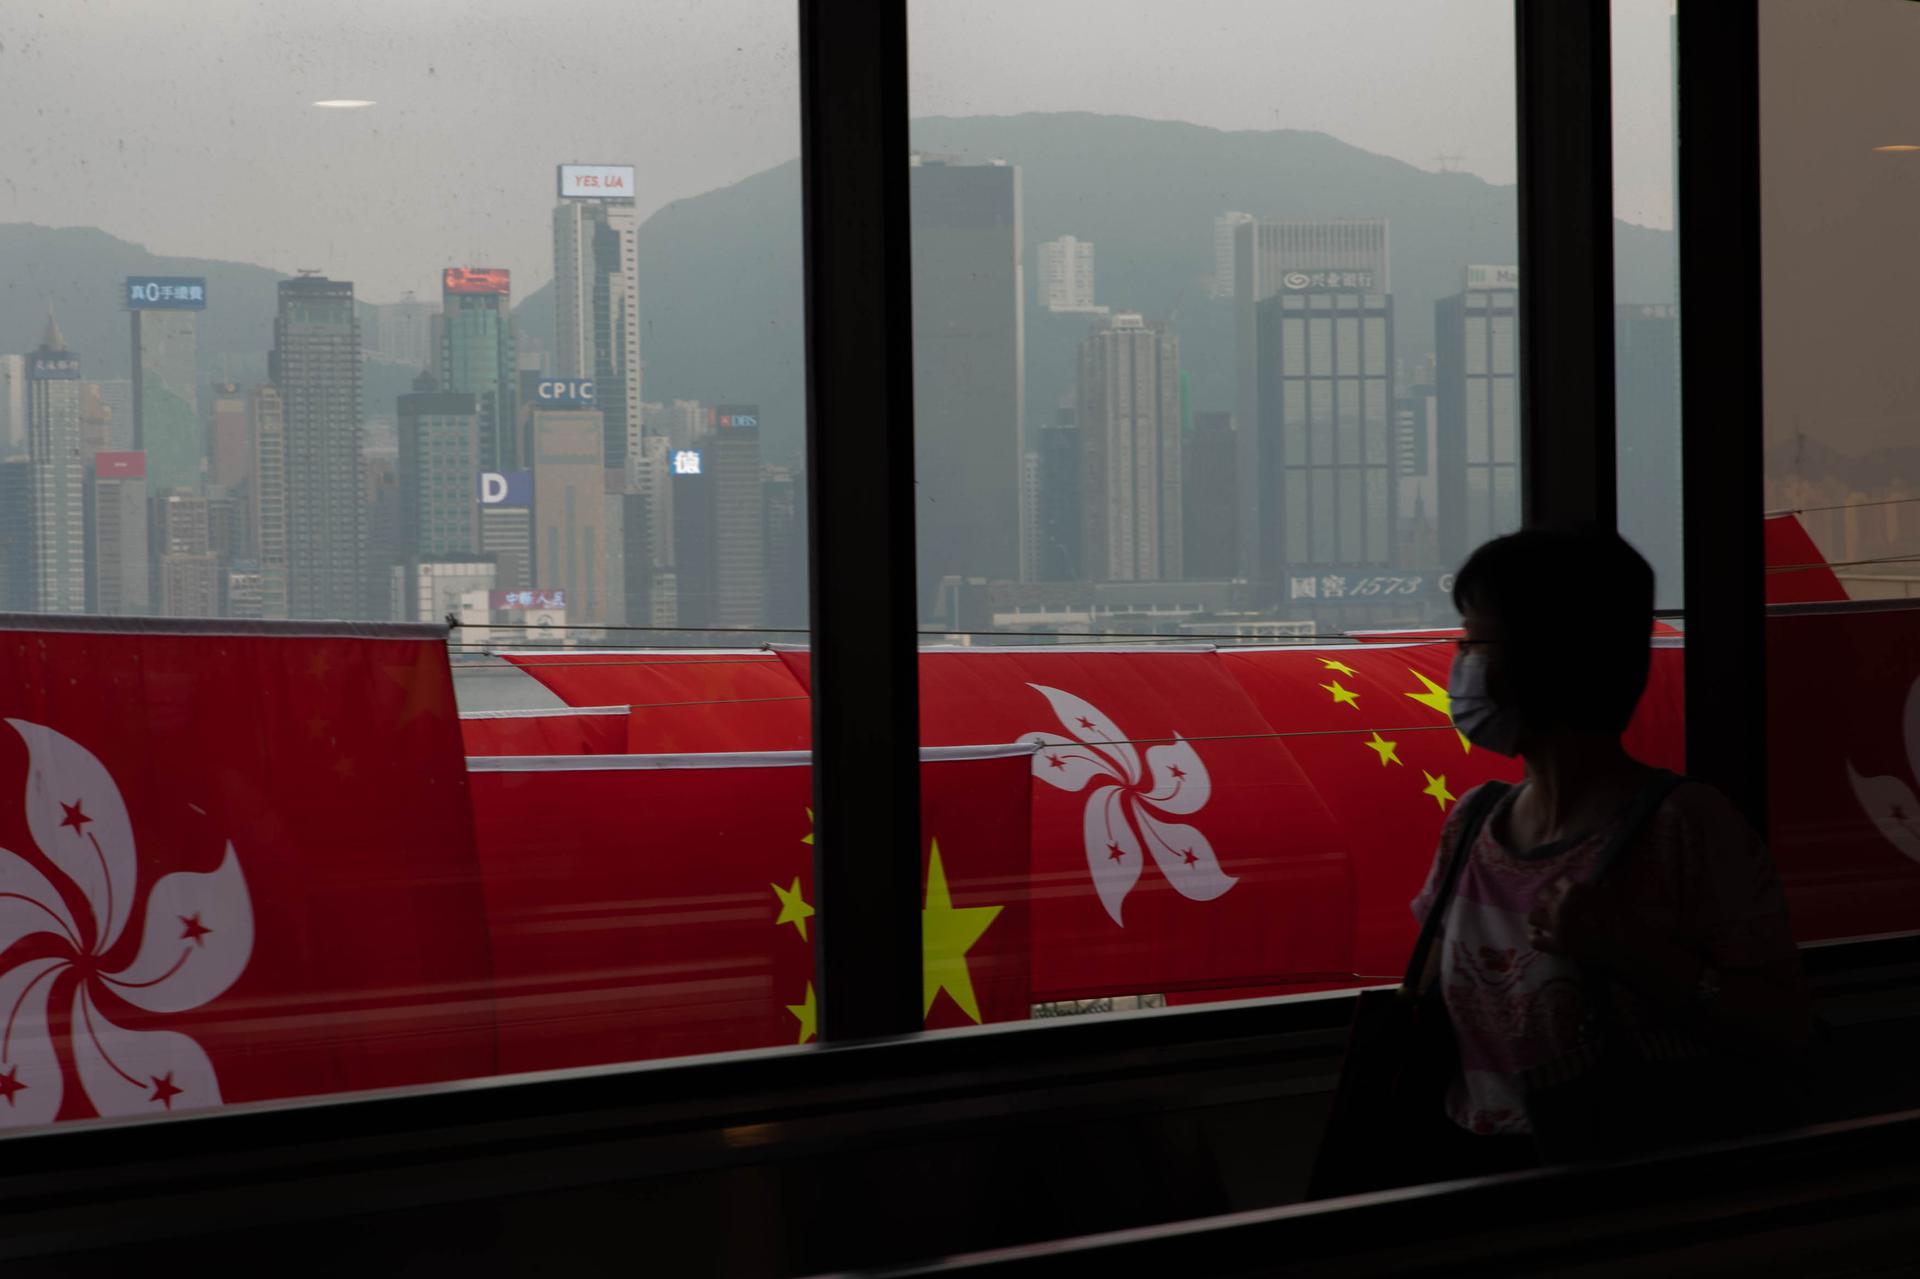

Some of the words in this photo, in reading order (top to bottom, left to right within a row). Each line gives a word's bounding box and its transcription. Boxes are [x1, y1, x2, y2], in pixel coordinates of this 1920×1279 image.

[538, 382, 593, 399] CPIC
[731, 415, 758, 427] DBS
[481, 472, 508, 503] D
